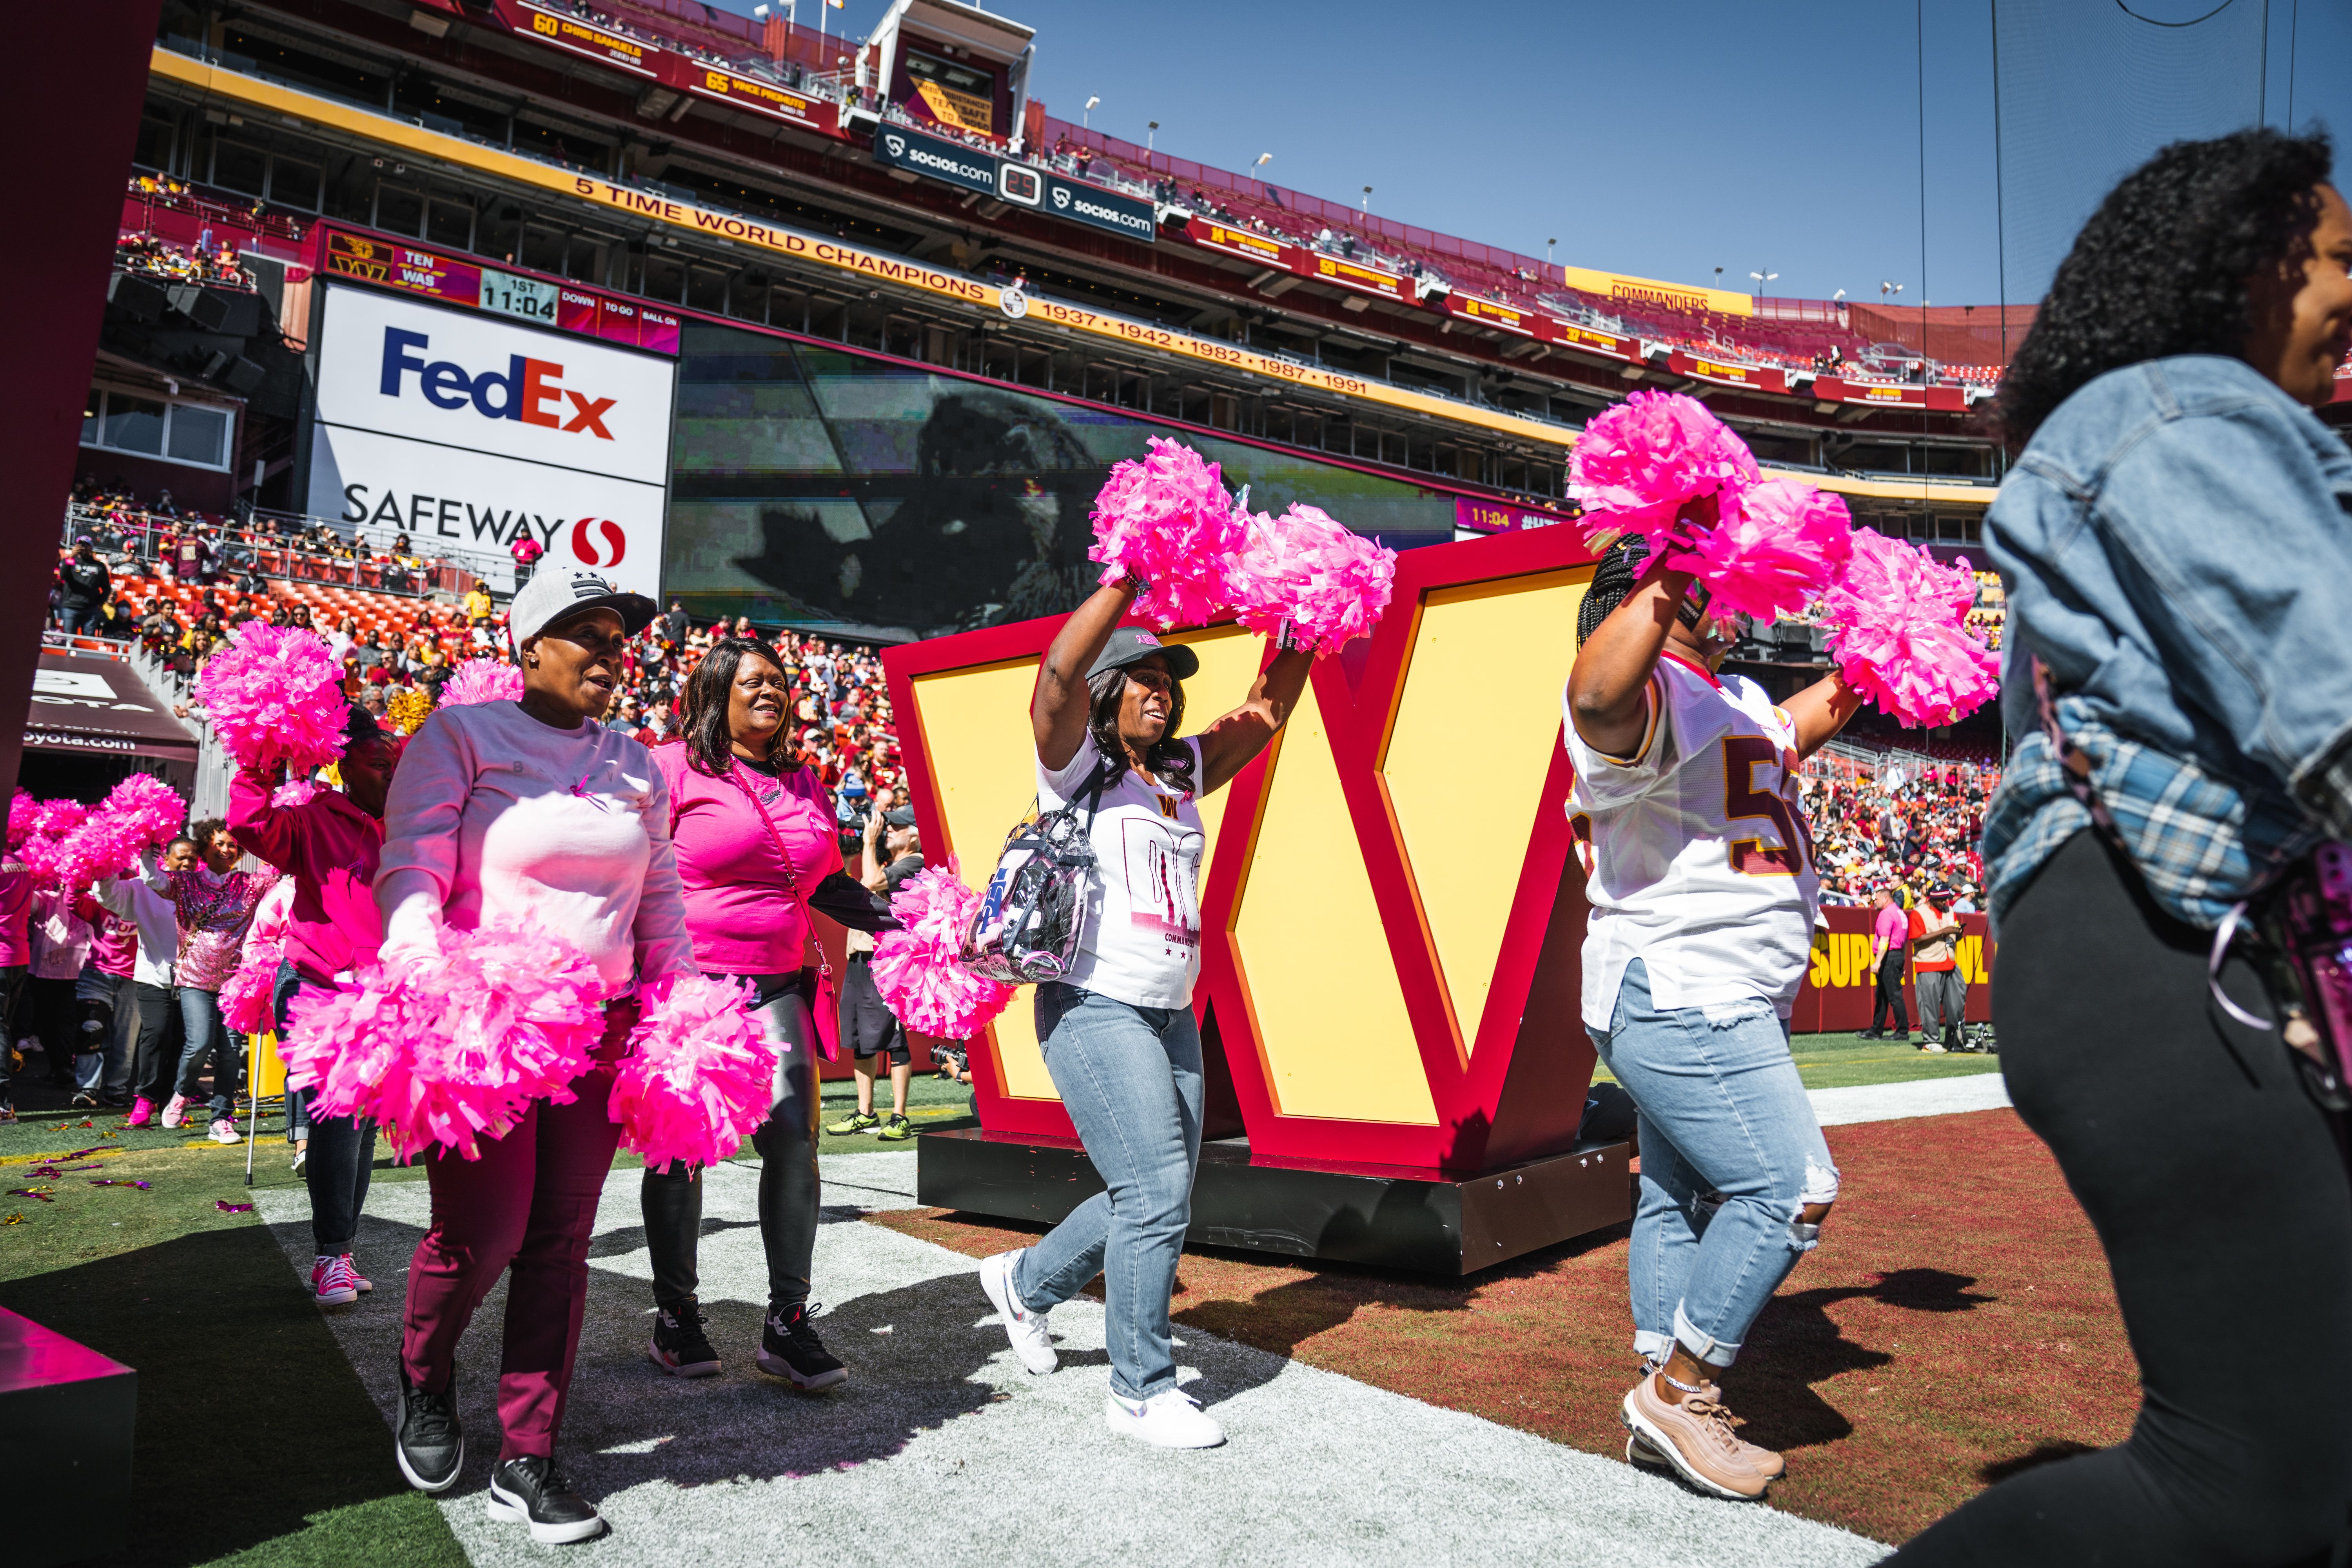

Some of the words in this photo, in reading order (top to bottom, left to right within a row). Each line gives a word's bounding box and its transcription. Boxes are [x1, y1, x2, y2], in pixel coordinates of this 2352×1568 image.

[534, 13, 558, 36] 60
[561, 22, 593, 41] CHRIS
[593, 33, 642, 58] SAMUELS
[706, 71, 729, 93] 65
[731, 79, 761, 96] VINCE
[760, 88, 806, 110] PROMUTO
[932, 97, 956, 110] TEXT
[942, 111, 954, 121] TO
[1008, 172, 1034, 196] 25
[576, 178, 593, 194] 5
[605, 185, 681, 221] TIME
[694, 211, 805, 251] WORLD
[816, 244, 984, 299] CHAMPIONS
[405, 250, 434, 269] TEN
[1320, 258, 1336, 276] 59
[402, 269, 435, 287] WAS
[512, 280, 537, 294] 1ST
[485, 287, 555, 320] 11:04
[562, 291, 595, 308] DOWN
[1466, 299, 1479, 316] 21
[1613, 285, 1708, 312] COMMANDERS
[604, 301, 618, 313] TO
[619, 305, 633, 316] GO
[642, 311, 664, 323] BALL
[665, 316, 677, 326] ON
[1566, 327, 1581, 342] 37
[1042, 303, 1096, 327] 1937
[1118, 323, 1171, 347] 1942
[1191, 341, 1241, 364] 1982
[1259, 358, 1306, 380] 1987
[1324, 374, 1367, 394] 1991
[380, 326, 617, 441] FedEx
[342, 484, 564, 552] SAFEWAY
[1473, 508, 1510, 527] 11:04
[31, 695, 154, 712] OTA
[24, 731, 136, 750] oyota.com
[1165, 933, 1195, 949] COMMANDERS
[1810, 933, 1905, 988] SUP
